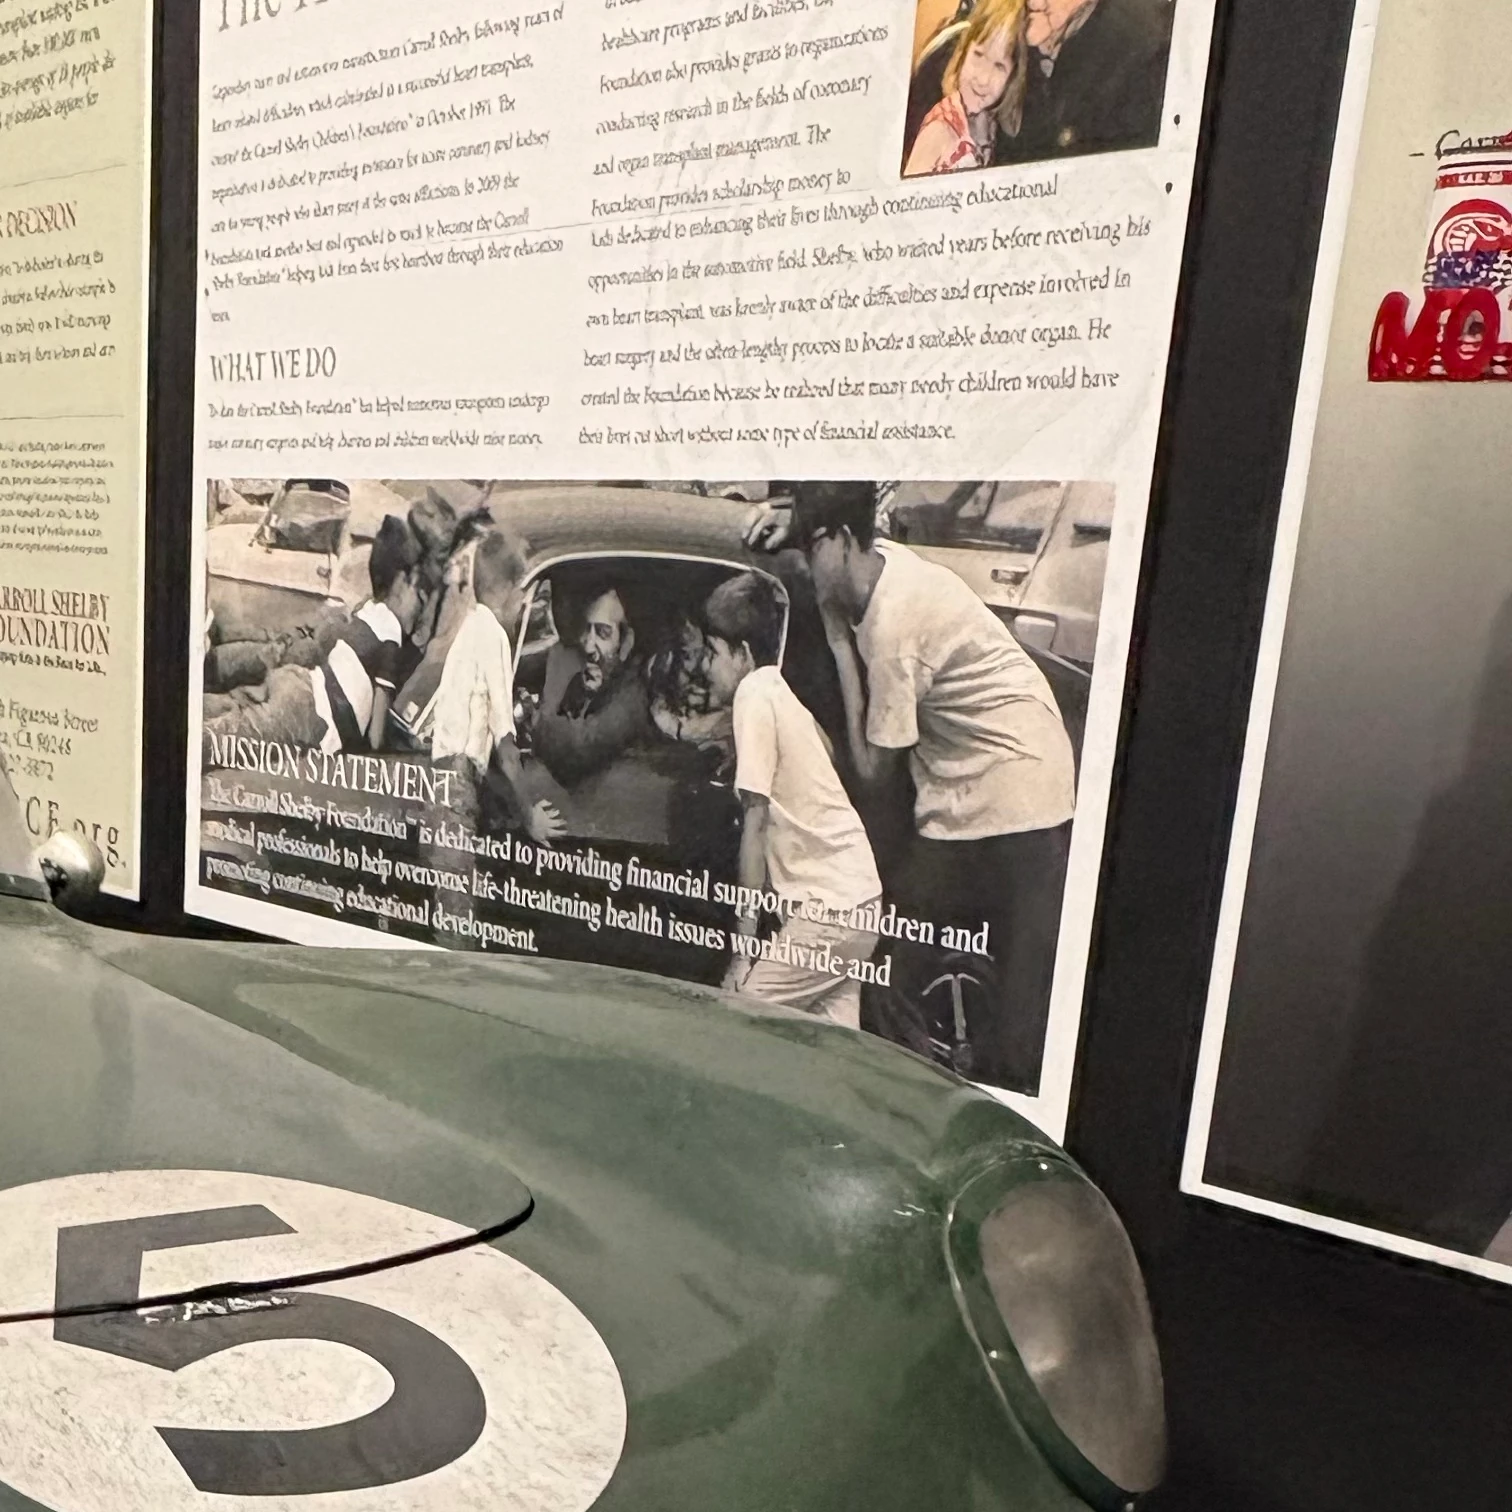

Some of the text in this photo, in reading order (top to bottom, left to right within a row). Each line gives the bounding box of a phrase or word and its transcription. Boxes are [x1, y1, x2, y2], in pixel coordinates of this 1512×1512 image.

[993, 225, 1042, 251] before
[1126, 214, 1152, 238] his
[941, 278, 970, 301] and
[1088, 317, 1112, 341] He
[210, 346, 336, 383] WHAT WE DO
[958, 369, 1022, 395] children
[1026, 366, 1076, 390] would
[1082, 366, 1120, 389] have
[51, 589, 110, 622] SHELBY
[205, 727, 457, 808] MISSION STATEMENT
[280, 791, 326, 831] Shelby
[419, 818, 432, 844] is
[435, 820, 512, 862] dedicated
[515, 840, 534, 865] to
[537, 847, 622, 892] providing
[627, 856, 709, 901] financial
[940, 921, 989, 956] and
[257, 828, 341, 867] professionals
[344, 847, 359, 870] to
[361, 845, 392, 885] help
[395, 860, 470, 894] overcome
[472, 867, 602, 932] life-threatening
[605, 896, 664, 938] health
[668, 911, 726, 951] issues
[730, 931, 844, 978] worldwide
[847, 954, 892, 987] and
[346, 883, 429, 927] educational
[433, 902, 539, 953] development.
[53, 1204, 487, 1497] 5
